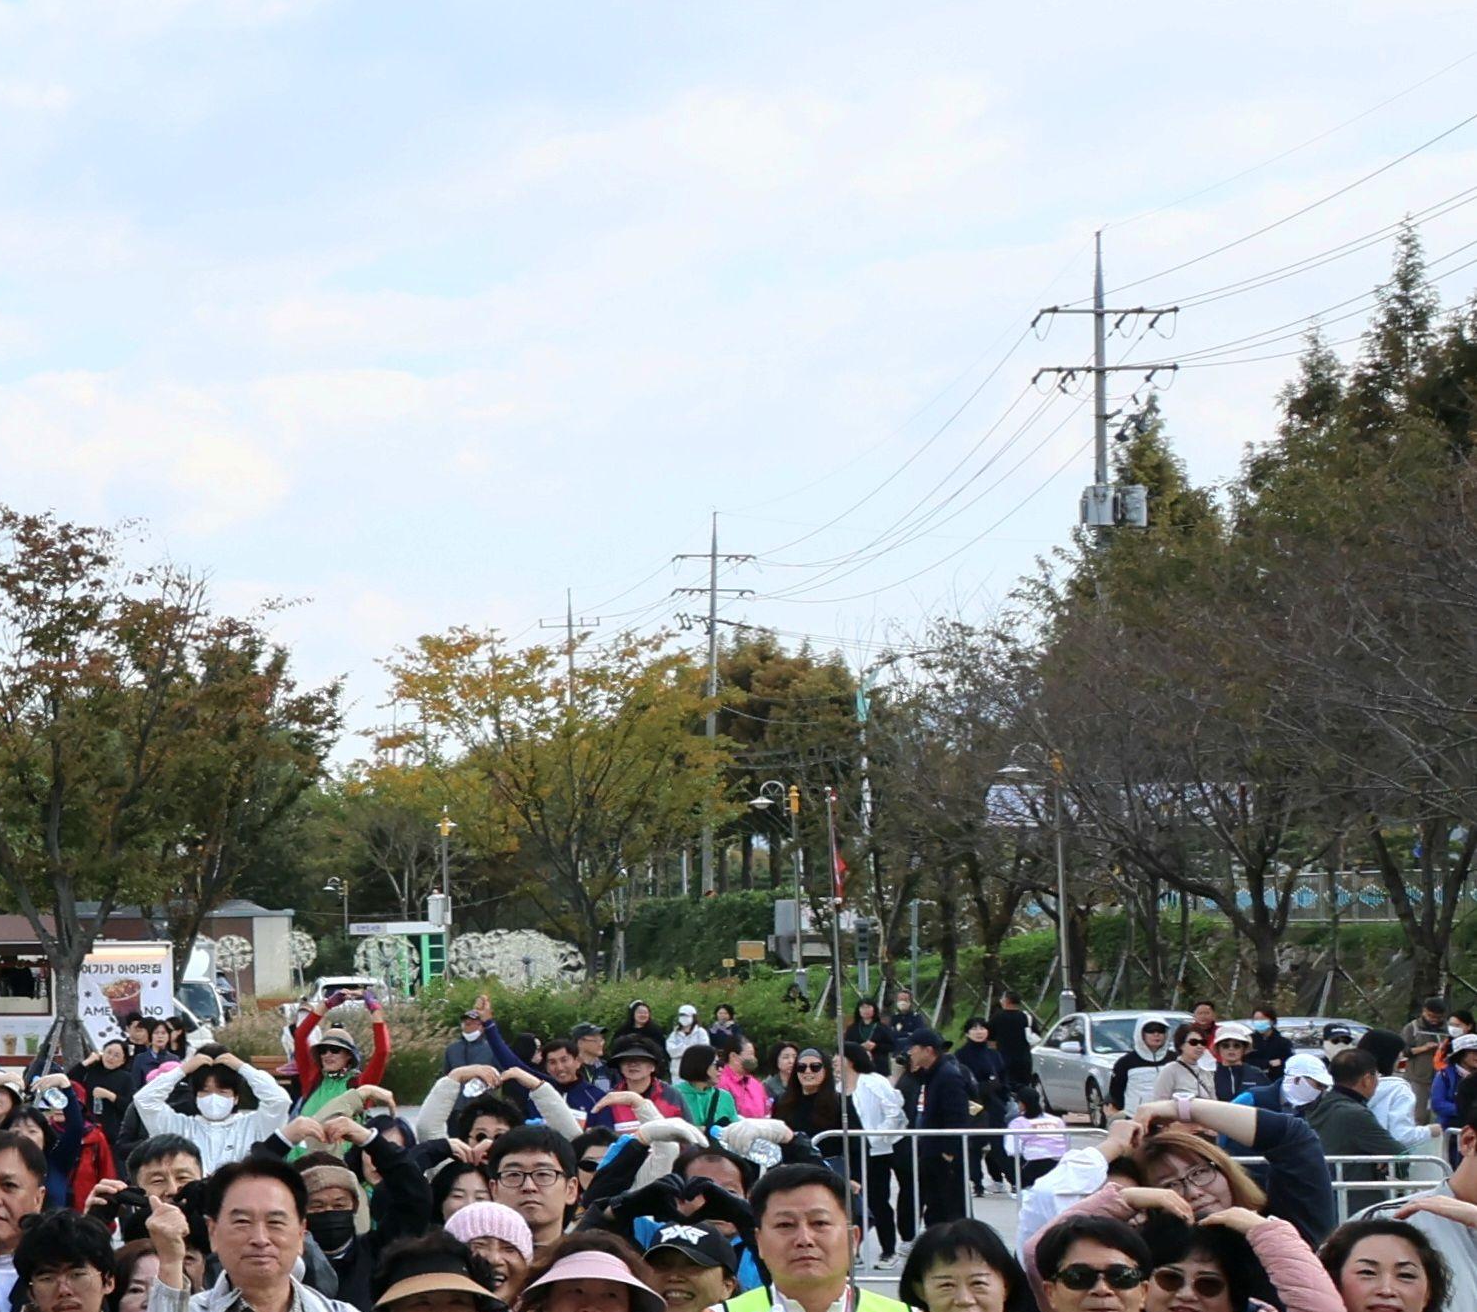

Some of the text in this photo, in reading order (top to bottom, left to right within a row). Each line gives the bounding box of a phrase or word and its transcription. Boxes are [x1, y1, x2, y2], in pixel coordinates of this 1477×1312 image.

[81, 963, 162, 975] 여기가 아아맛집
[659, 1225, 710, 1245] PXG
